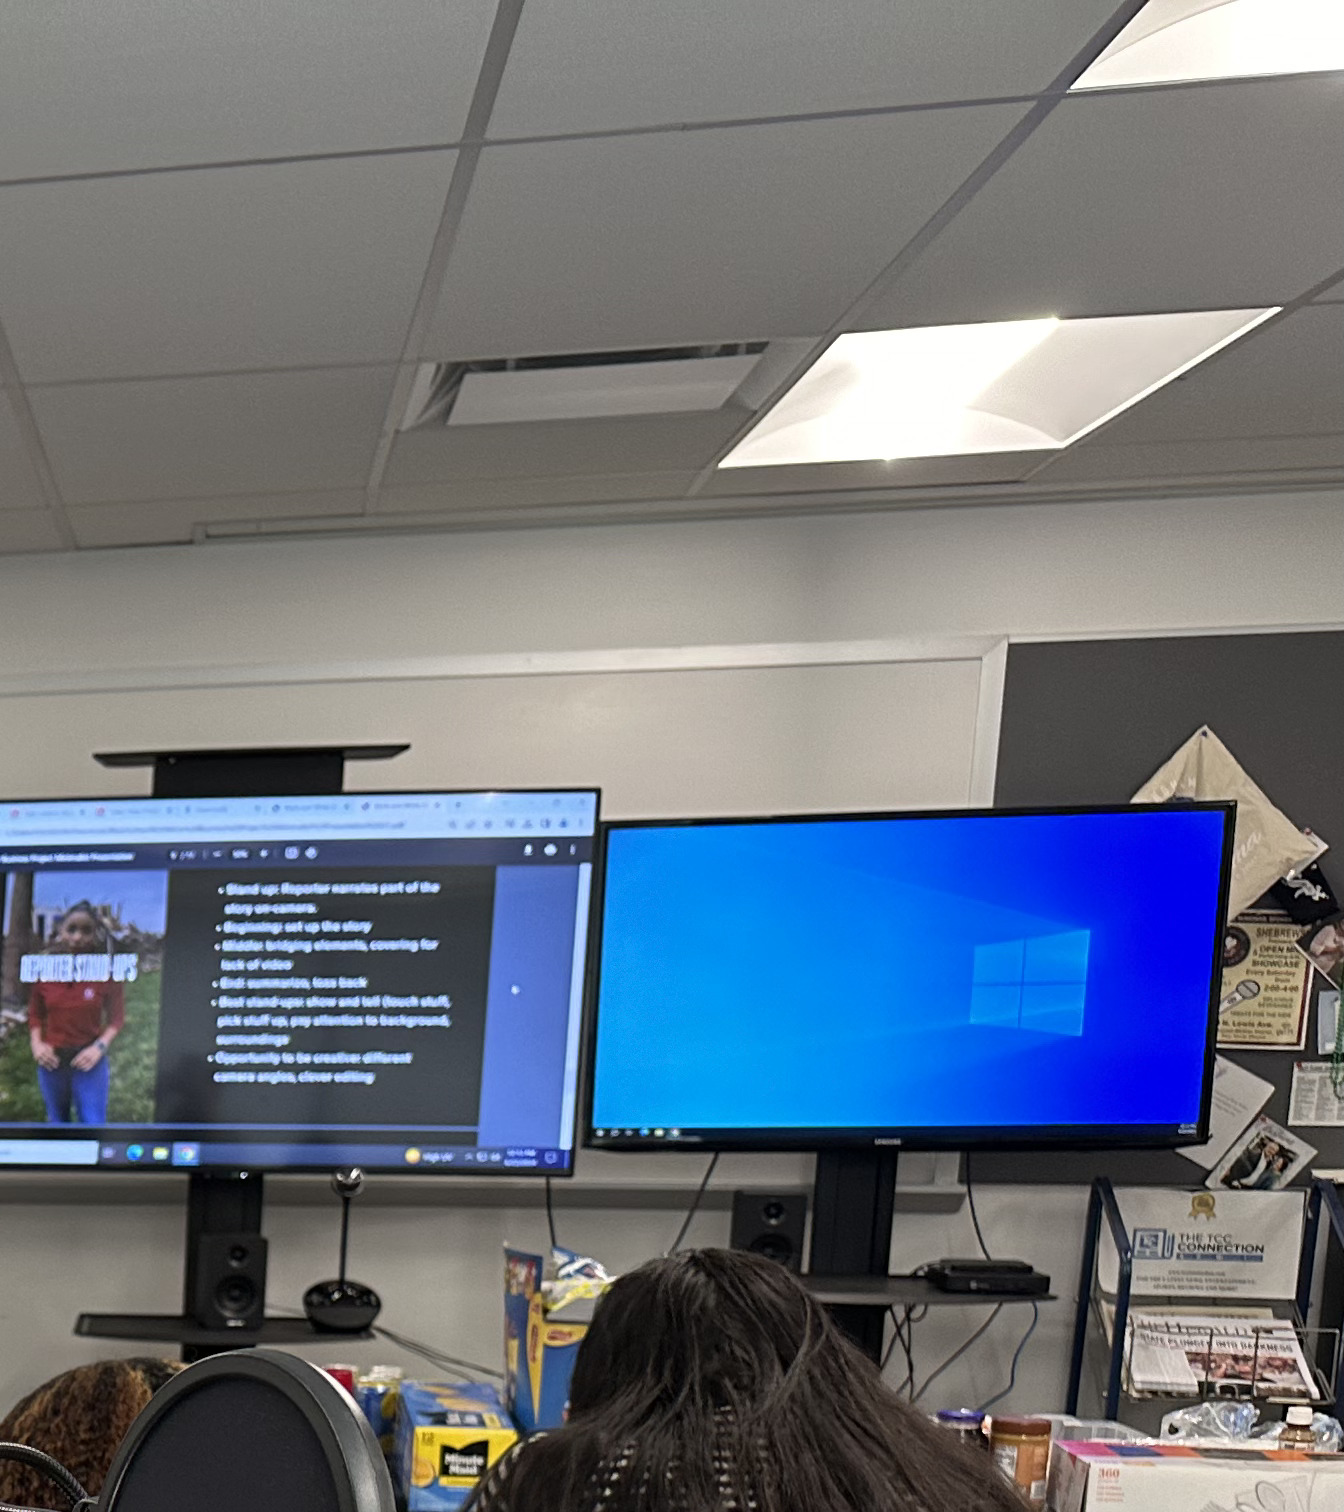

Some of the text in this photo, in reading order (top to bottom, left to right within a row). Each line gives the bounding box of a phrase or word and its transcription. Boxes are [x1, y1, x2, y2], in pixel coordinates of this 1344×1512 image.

[1178, 1232, 1204, 1243] THE
[1177, 1243, 1265, 1254] CONNECTION
[444, 1452, 485, 1466] Minute
[448, 1464, 479, 1476] Maid
